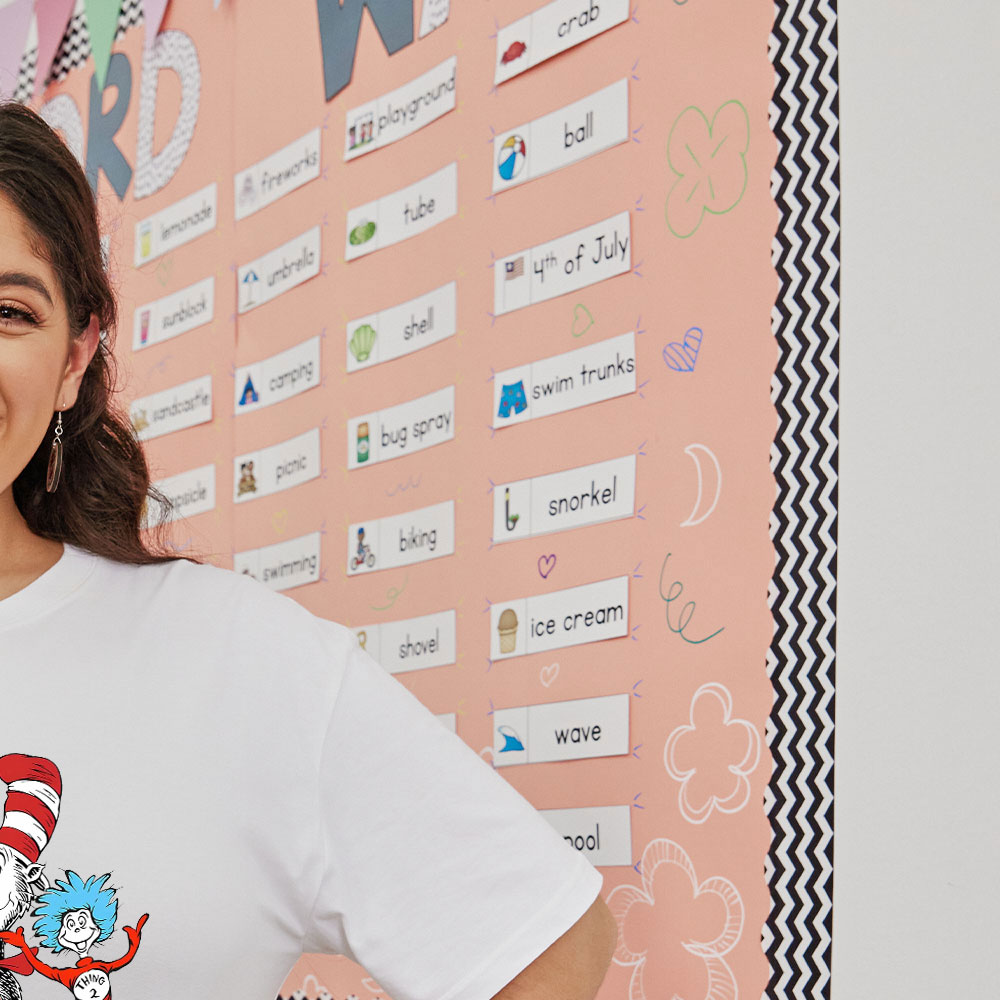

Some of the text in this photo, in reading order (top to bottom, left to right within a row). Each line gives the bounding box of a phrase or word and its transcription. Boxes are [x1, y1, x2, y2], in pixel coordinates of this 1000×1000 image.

[557, 0, 600, 38] crab
[378, 67, 457, 135] playground
[564, 110, 594, 149] ball
[261, 147, 318, 195] fireworks
[160, 201, 214, 242] lemonade
[403, 195, 436, 226] tube
[267, 246, 315, 288] umbrella
[534, 230, 629, 284] 4th of July
[162, 292, 208, 330] sunblock
[403, 305, 435, 341] shell
[268, 361, 314, 393] camping
[532, 352, 635, 400] swim trunks
[152, 388, 210, 423] sandcastle
[381, 410, 452, 449] bug spray
[275, 453, 308, 485] picnic
[548, 474, 617, 517] snorkel
[398, 527, 437, 553] biking
[262, 554, 318, 584] swimming
[530, 603, 624, 639] ice cream
[398, 627, 440, 660] shovel
[554, 724, 602, 745] wave
[74, 973, 106, 990] THING
[89, 988, 100, 999] 2
